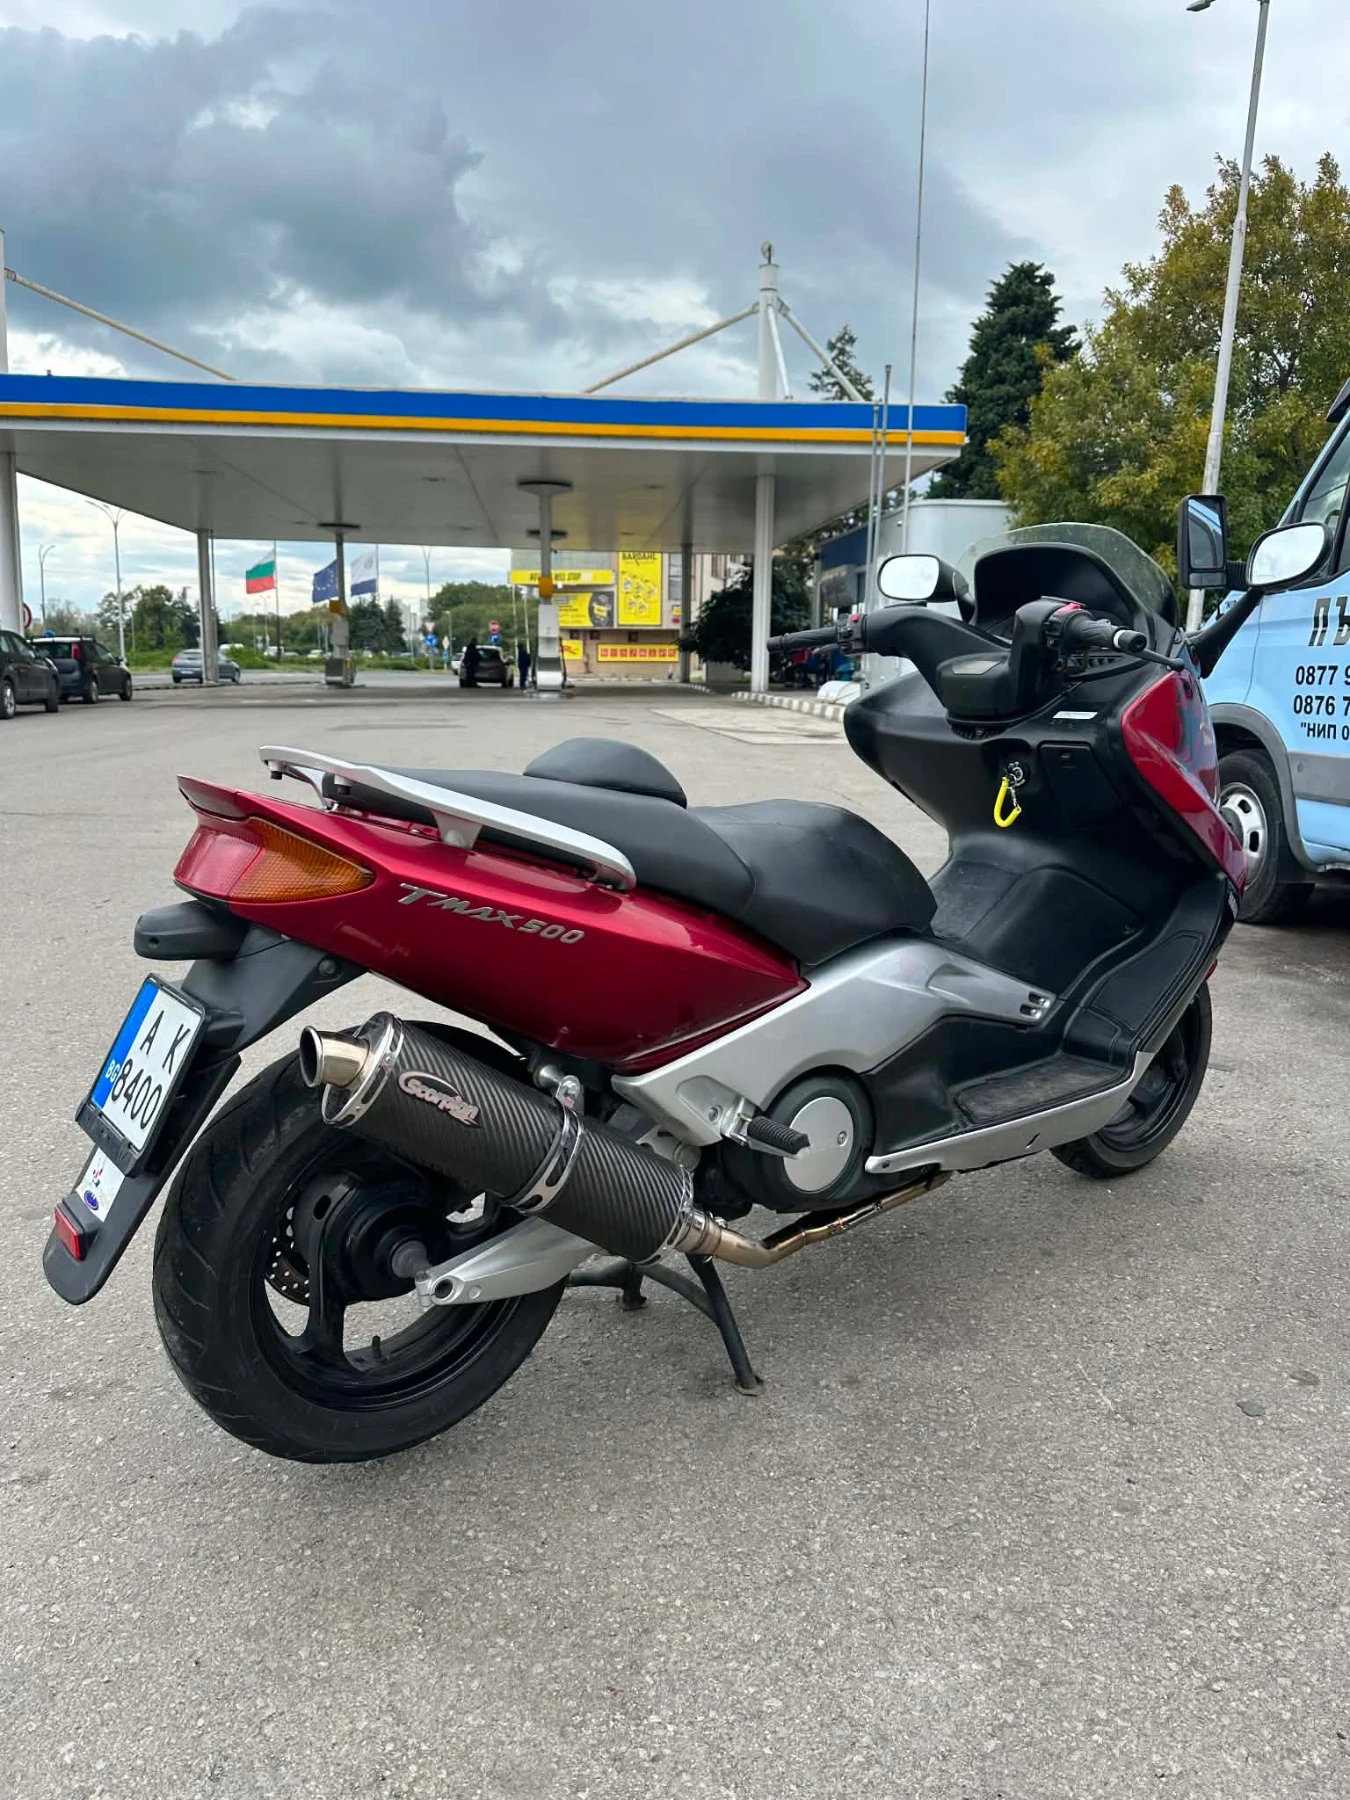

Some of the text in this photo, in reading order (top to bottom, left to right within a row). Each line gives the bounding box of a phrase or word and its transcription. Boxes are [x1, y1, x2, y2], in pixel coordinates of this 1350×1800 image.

[1295, 665, 1339, 686] 0877
[1293, 694, 1336, 716] 0876
[1300, 722, 1337, 740] "НИП
[105, 1059, 120, 1084] BG
[111, 1058, 163, 1130] 8400
[399, 1071, 481, 1126] Scorpion
